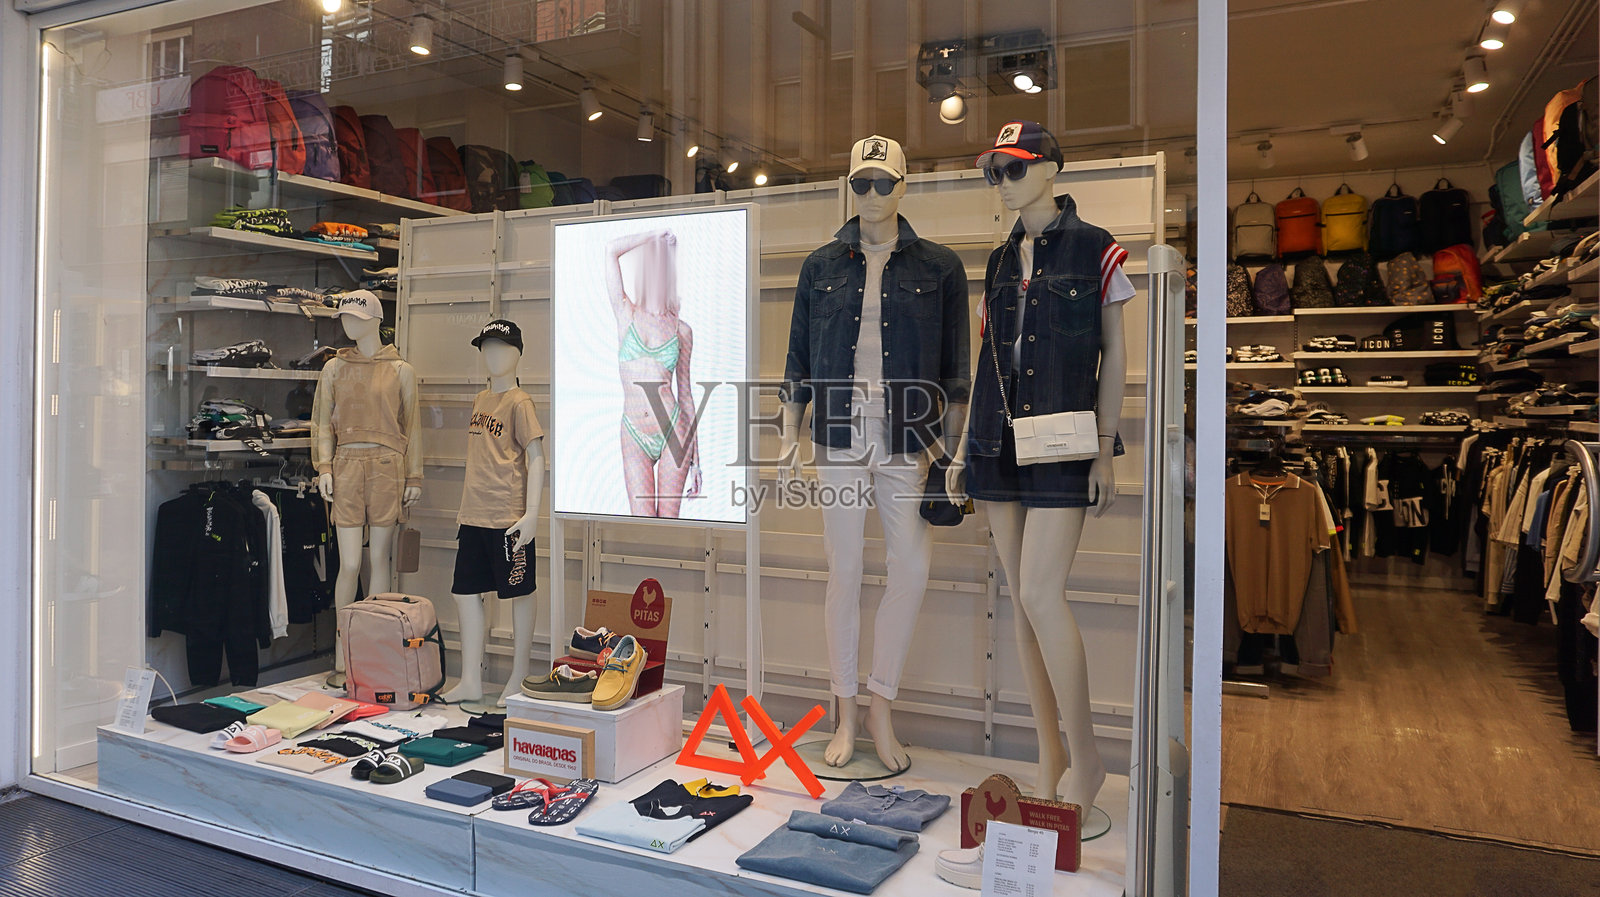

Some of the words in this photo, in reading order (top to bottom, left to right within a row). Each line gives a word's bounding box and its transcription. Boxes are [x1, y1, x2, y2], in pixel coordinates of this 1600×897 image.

[1433, 321, 1444, 344] ICON
[1364, 340, 1390, 349] ICON
[243, 439, 270, 456] ICON
[633, 609, 660, 622] PITAS
[513, 737, 577, 763] havaianas
[513, 755, 531, 763] ORIGINAL
[1030, 811, 1046, 820] WALK
[1030, 820, 1046, 828] WALK
[1053, 823, 1070, 831] PITAS
